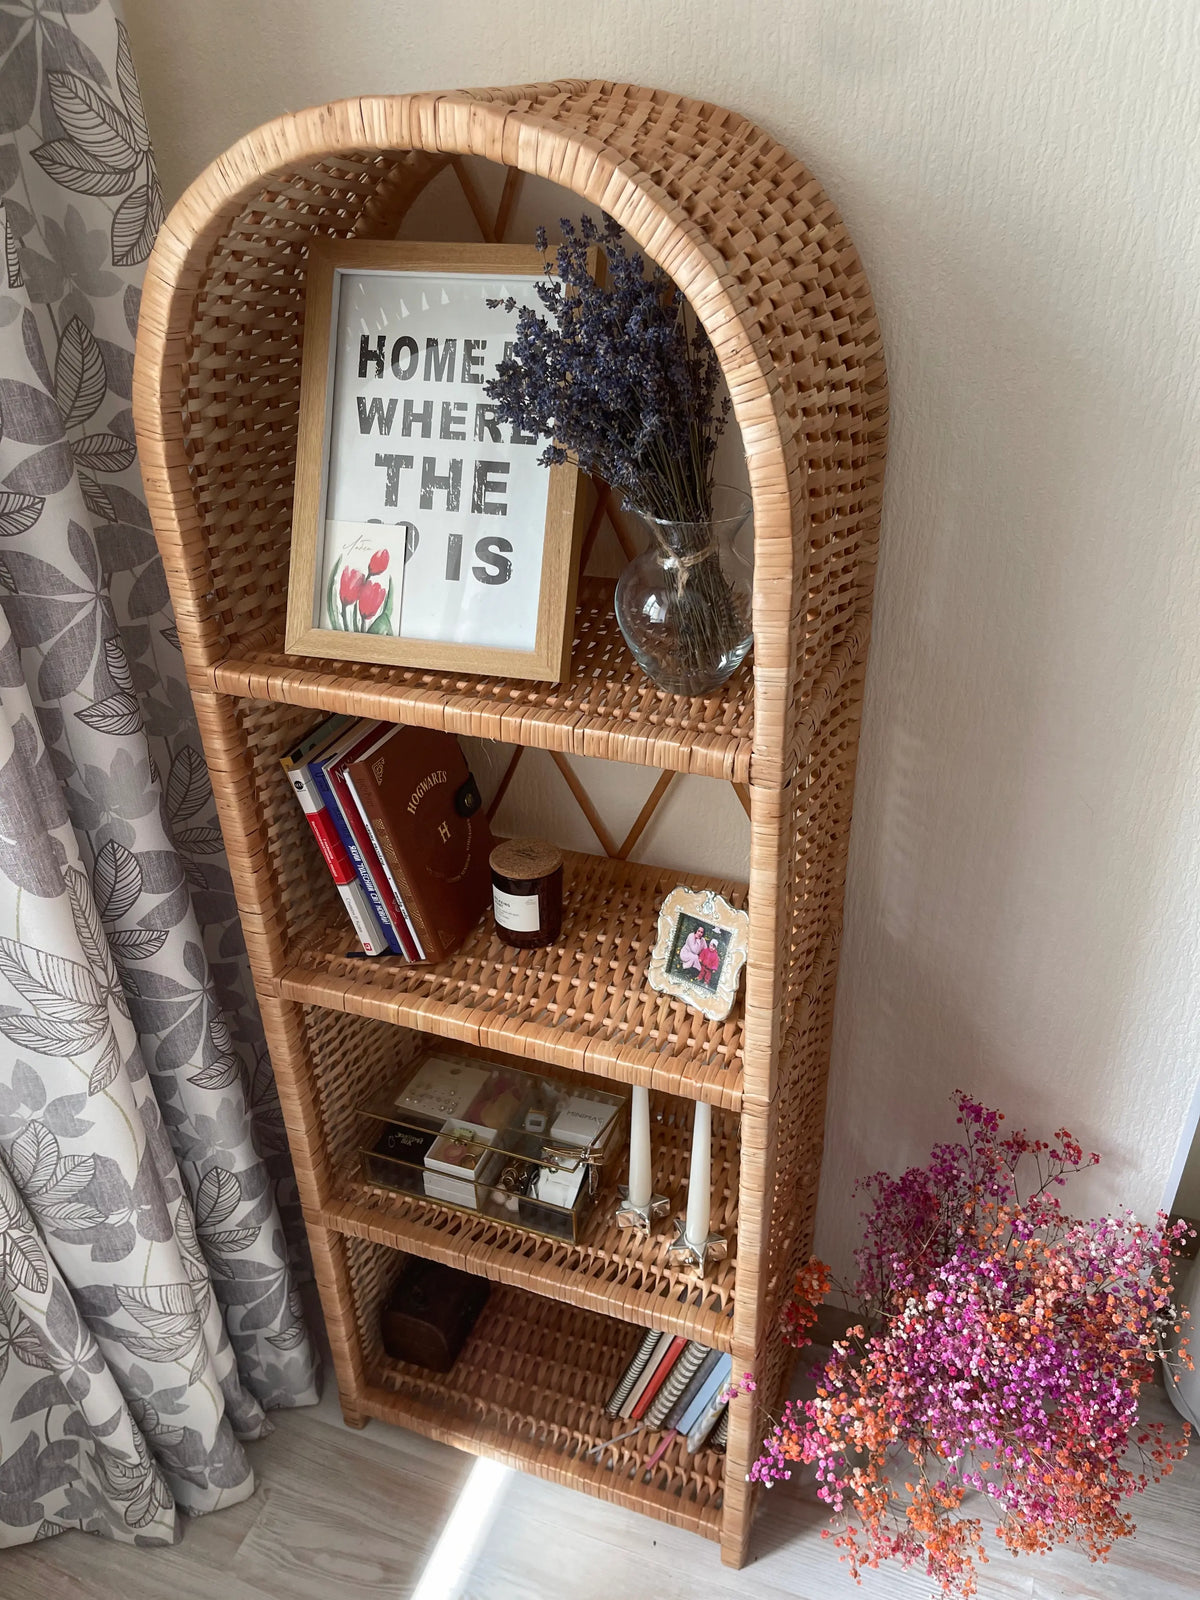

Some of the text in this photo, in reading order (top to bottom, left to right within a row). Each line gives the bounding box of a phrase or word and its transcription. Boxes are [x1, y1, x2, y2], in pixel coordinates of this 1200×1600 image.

[358, 334, 488, 385] HOME
[374, 452, 511, 516] THE
[445, 533, 514, 585] IS
[407, 770, 448, 815] HOGWARTS
[437, 820, 451, 844] H
